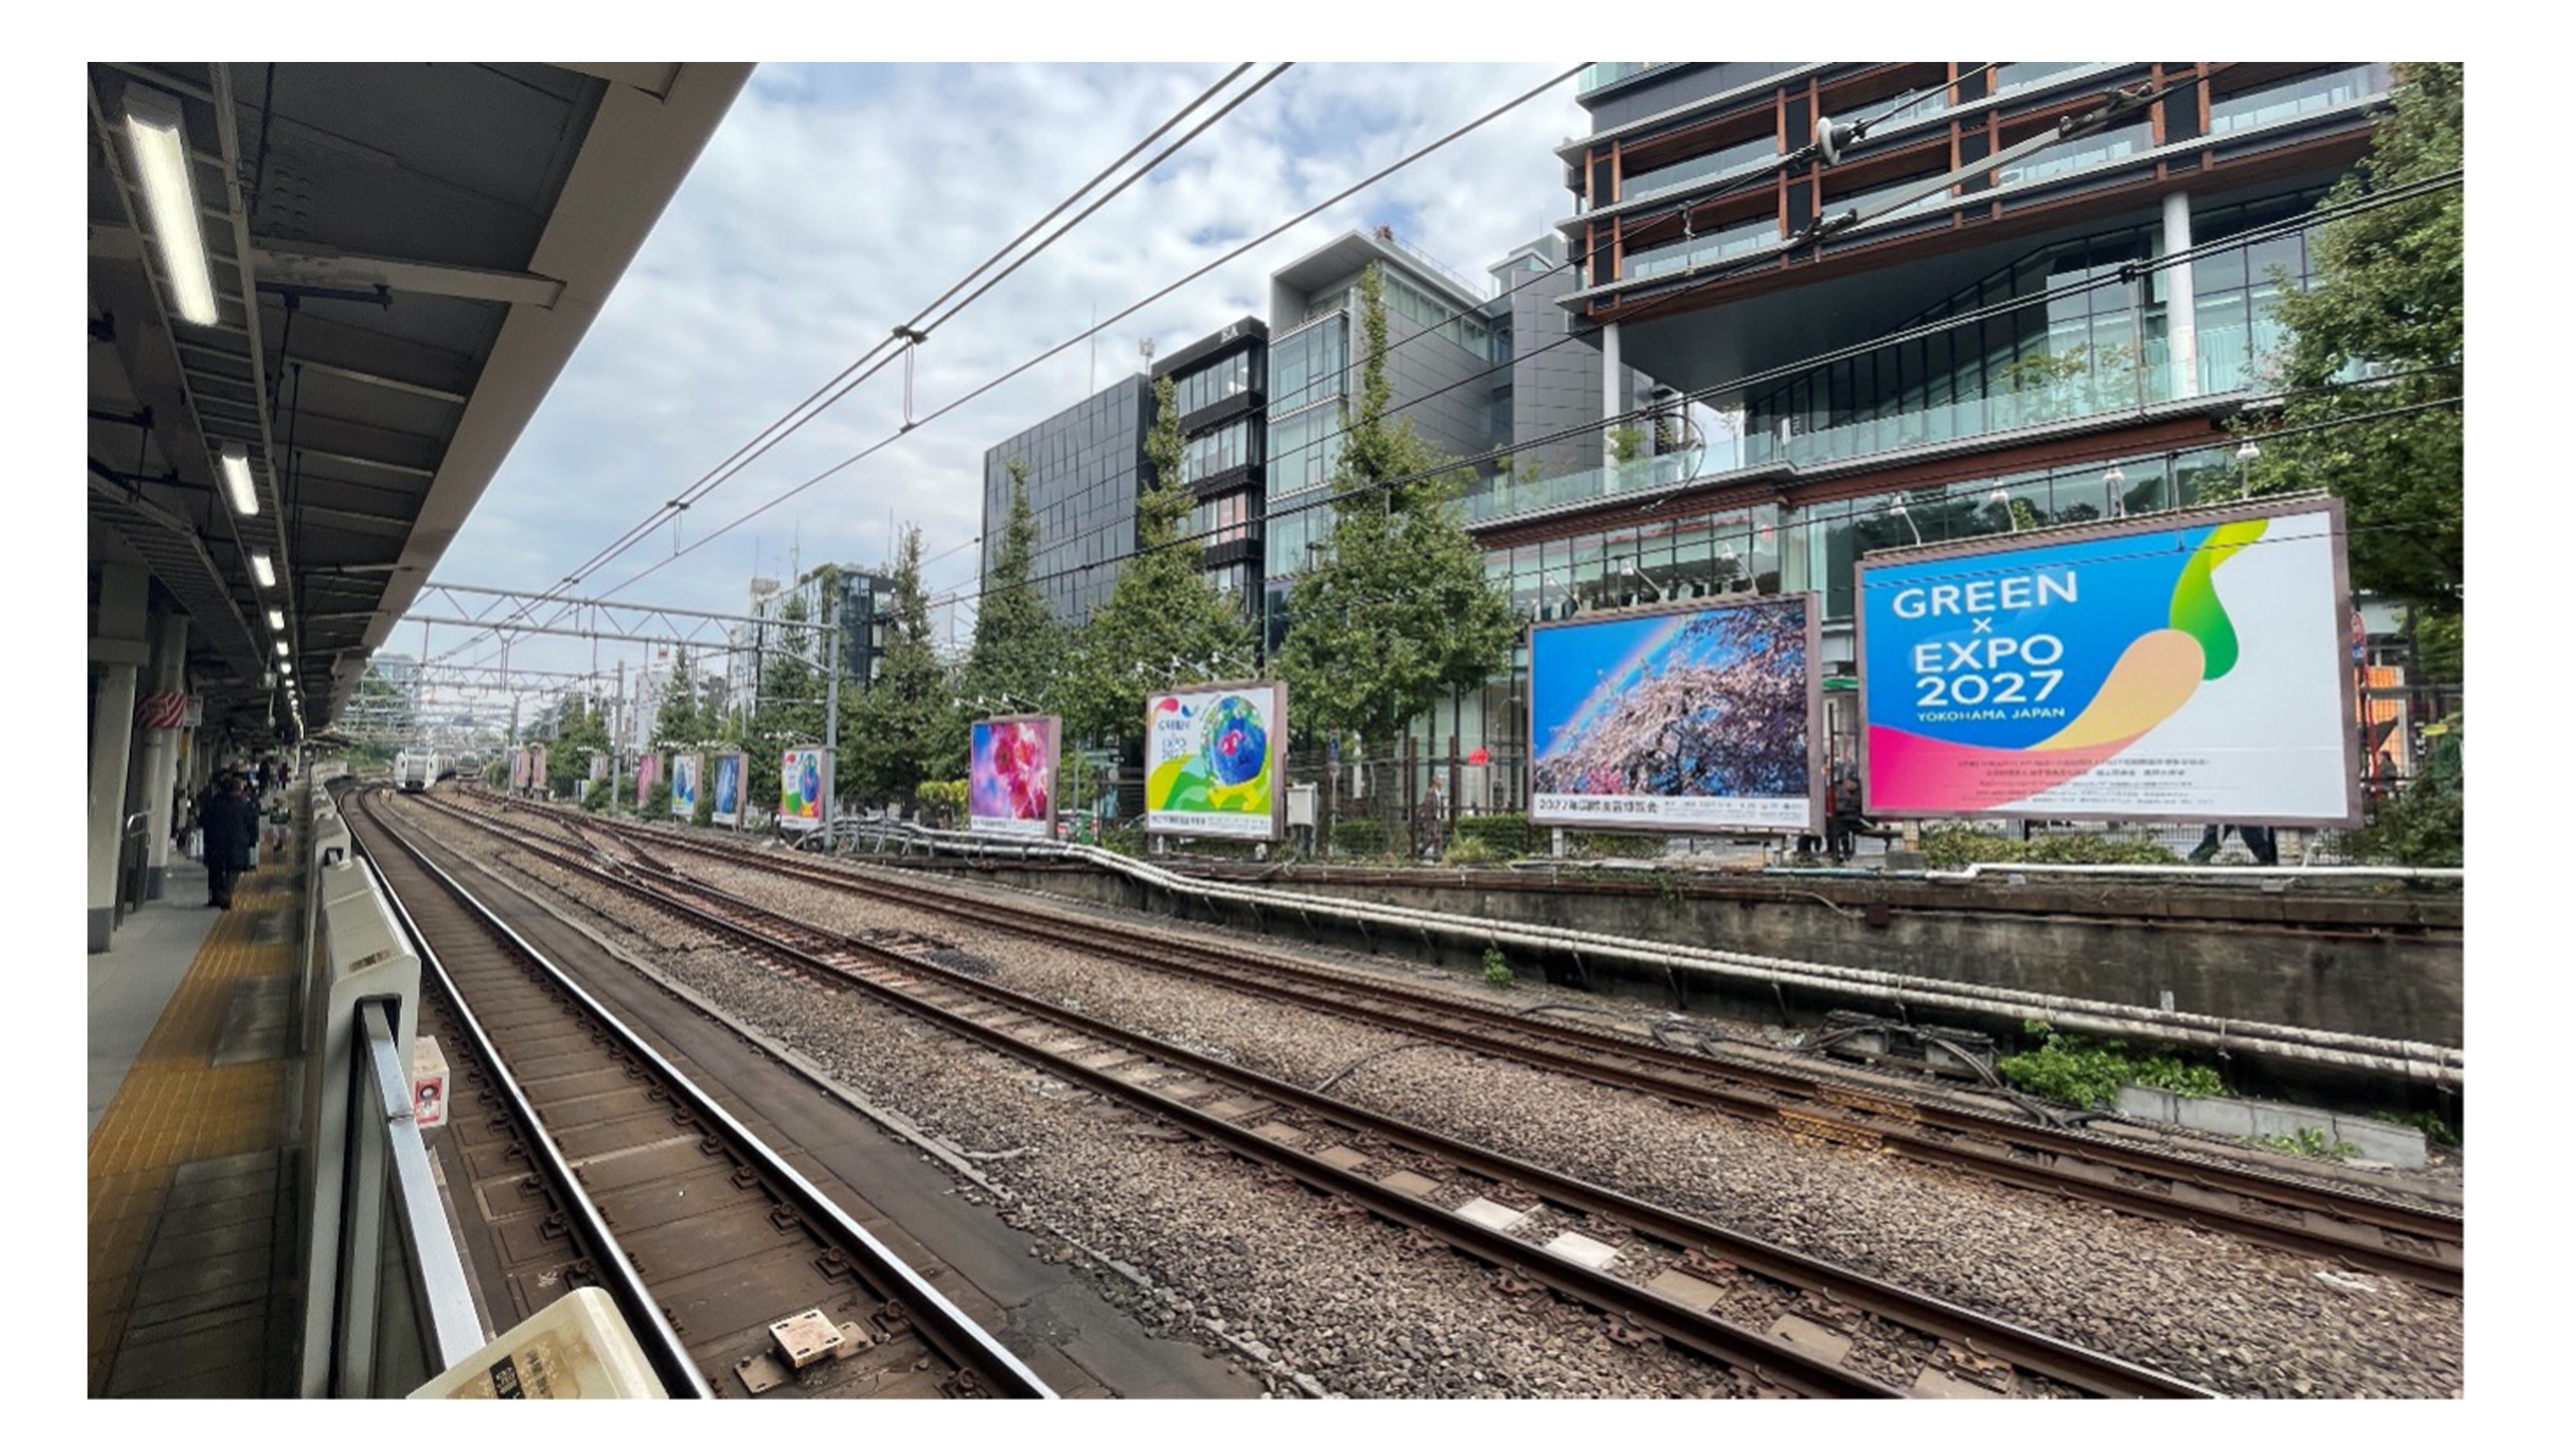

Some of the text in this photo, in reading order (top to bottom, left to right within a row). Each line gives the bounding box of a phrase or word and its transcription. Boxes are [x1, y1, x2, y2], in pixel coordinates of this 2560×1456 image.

[1893, 571, 2077, 618] GREEN
[1914, 634, 2064, 674] EXPO
[1916, 669, 2064, 706] 2027
[1917, 707, 2066, 722] YOKOHAMA JAPAN
